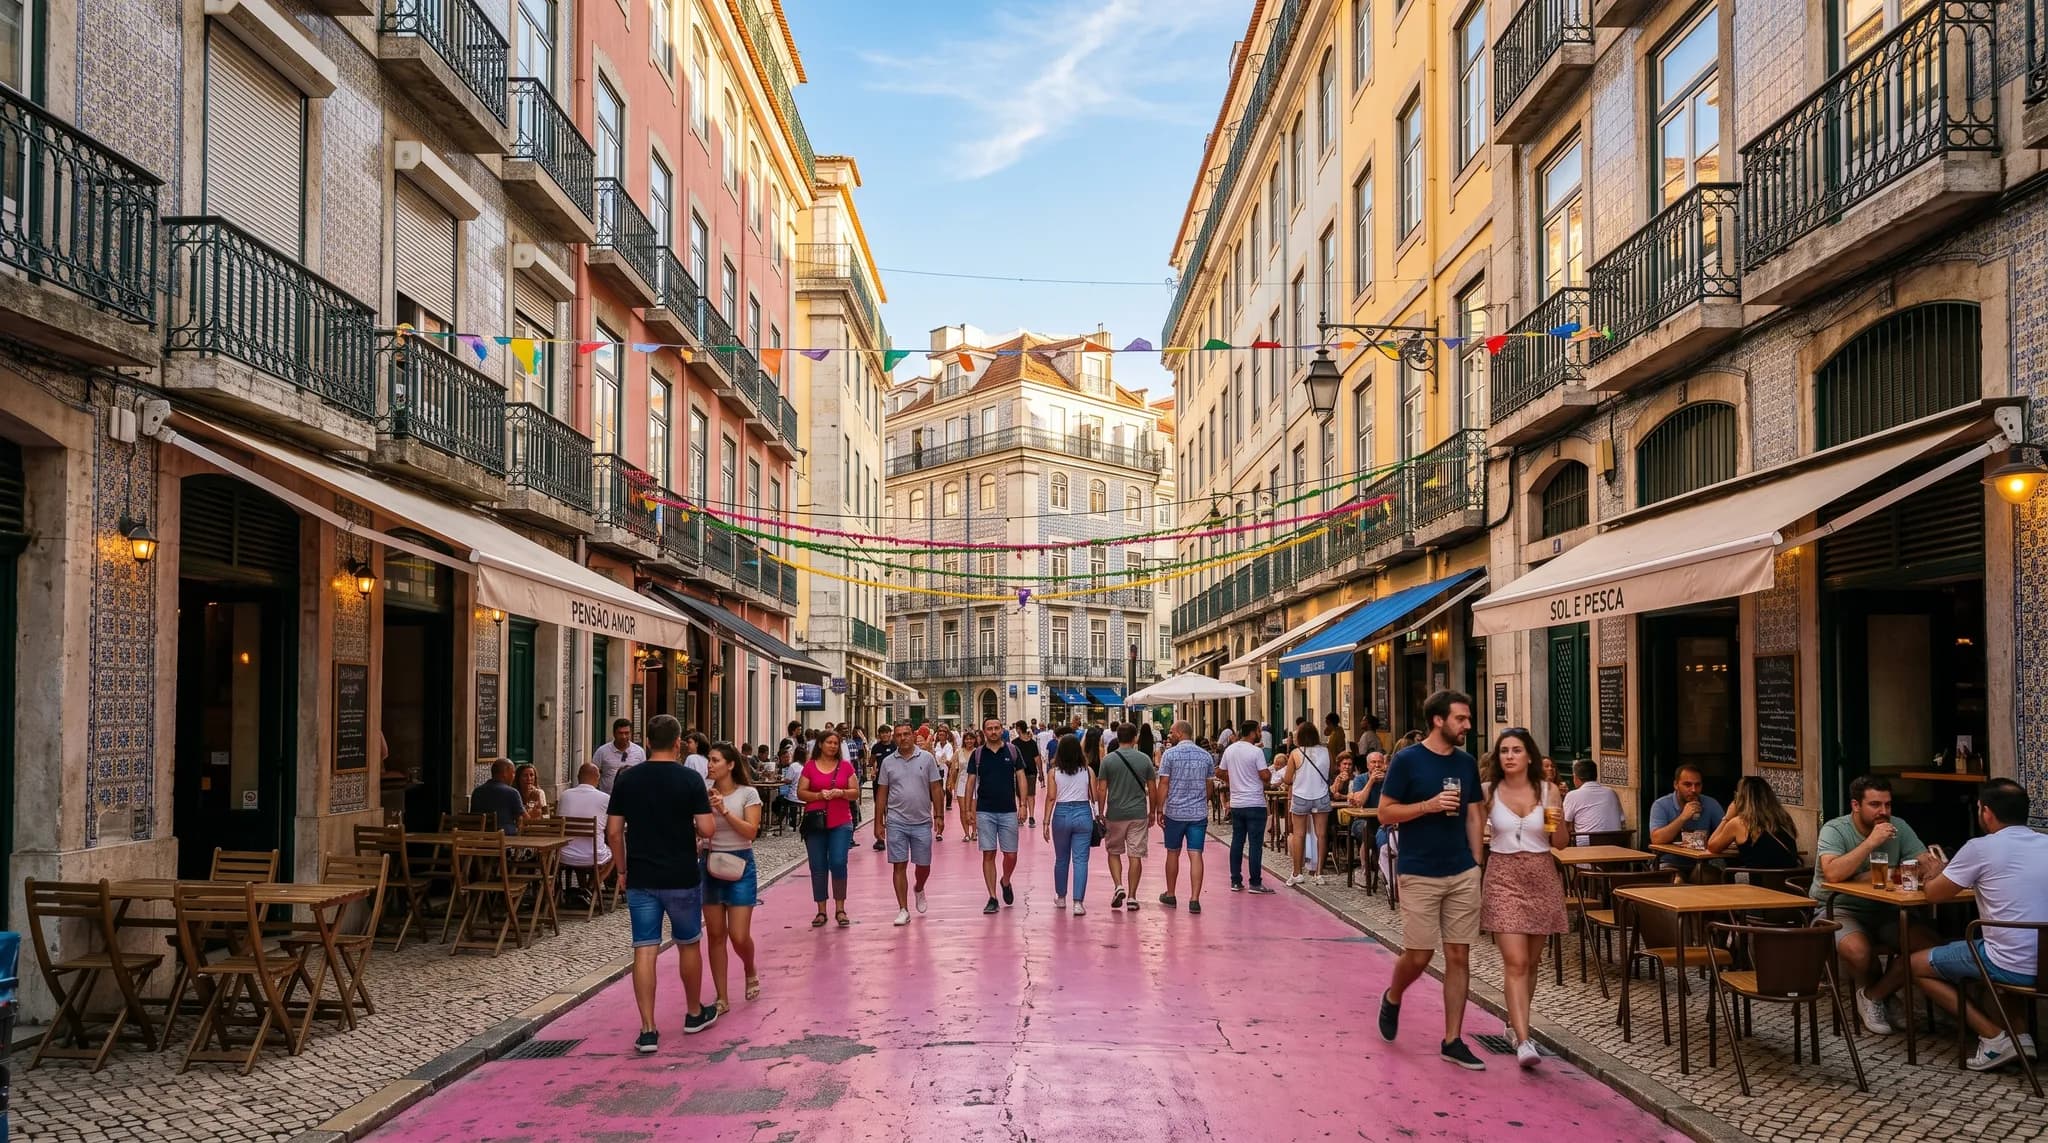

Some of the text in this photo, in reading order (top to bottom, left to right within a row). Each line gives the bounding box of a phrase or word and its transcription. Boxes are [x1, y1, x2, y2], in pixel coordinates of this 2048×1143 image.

[571, 600, 636, 636] PENSÃO AMOR
[1550, 586, 1625, 621] SOL E PESCA
